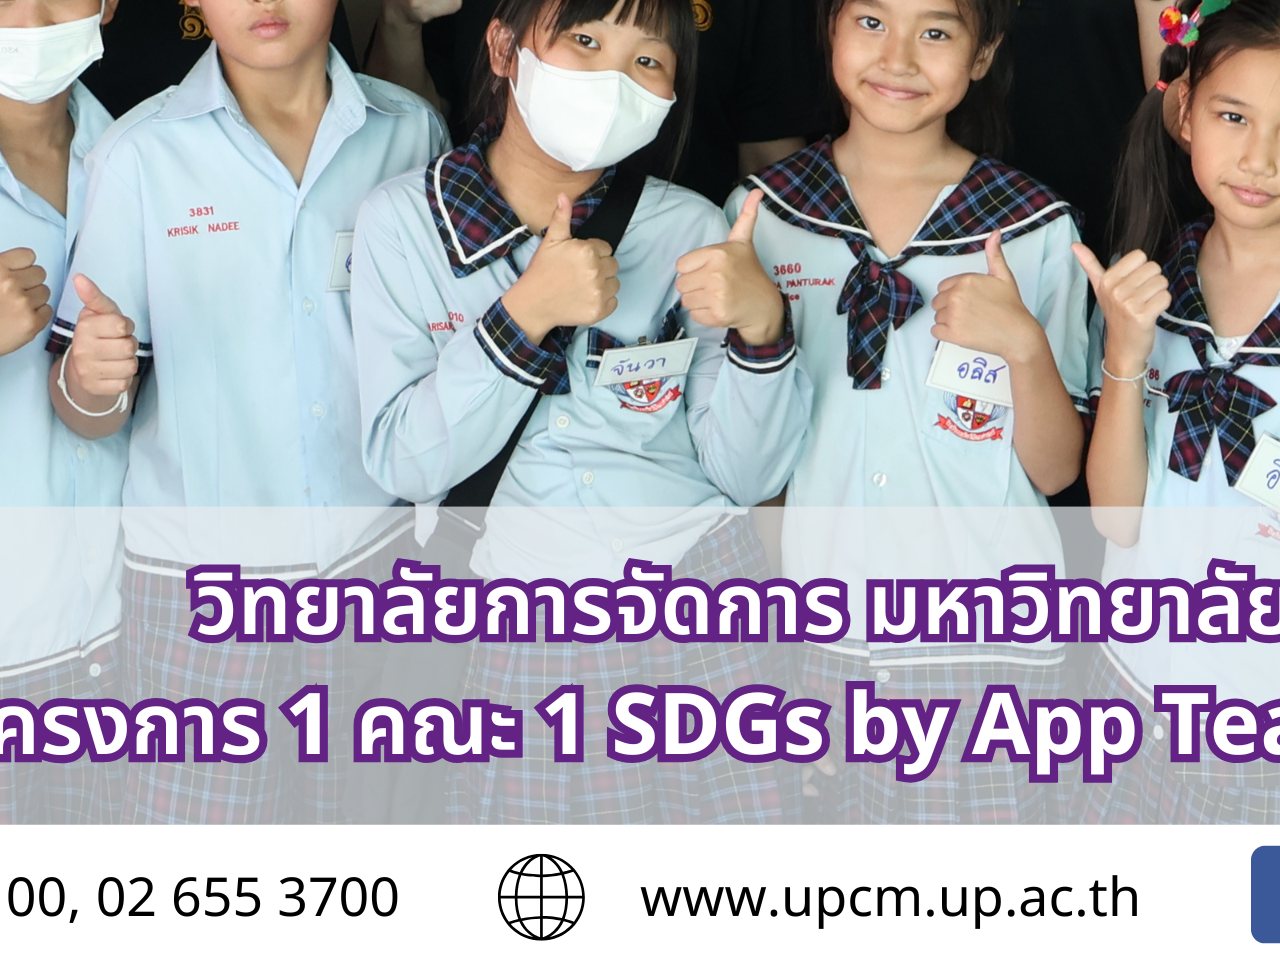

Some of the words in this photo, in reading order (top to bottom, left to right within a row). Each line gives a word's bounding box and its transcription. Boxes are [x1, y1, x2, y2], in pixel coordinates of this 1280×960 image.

[189, 206, 214, 217] 3831
[167, 225, 199, 237] KRISIK
[208, 221, 240, 233] NADEE
[773, 263, 802, 276] 3660
